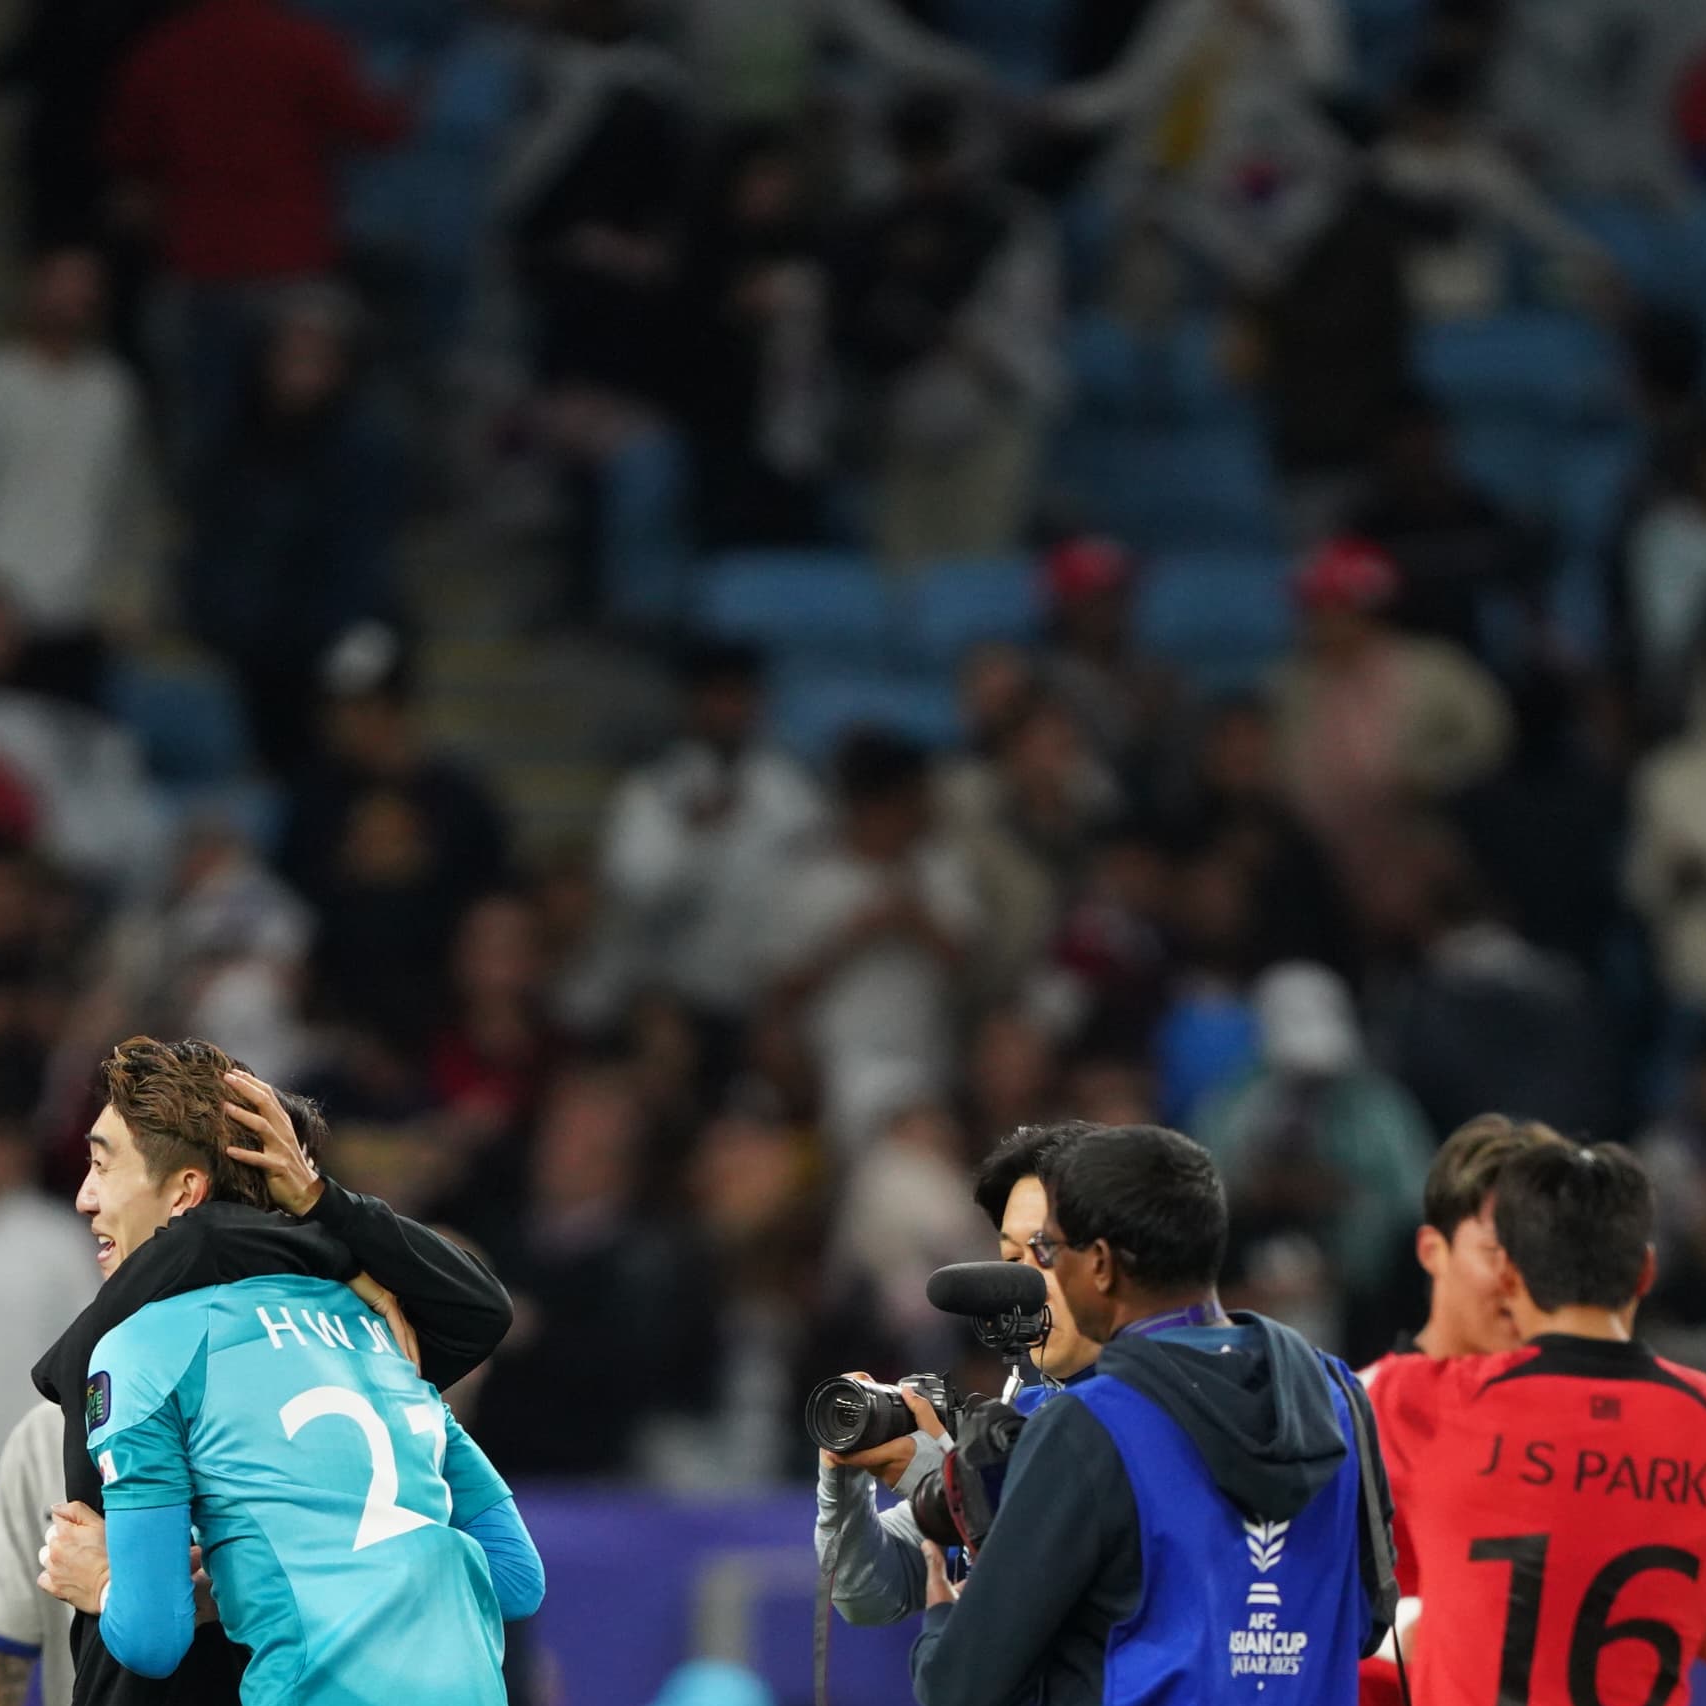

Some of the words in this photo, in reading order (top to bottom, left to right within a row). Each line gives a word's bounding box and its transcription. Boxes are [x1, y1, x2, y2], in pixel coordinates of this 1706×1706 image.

[1477, 1434, 1503, 1477] J
[1519, 1441, 1557, 1487] S
[1248, 1612, 1277, 1631] AFC
[1273, 1631, 1308, 1655] CUP
[1231, 1655, 1267, 1679] ATAR
